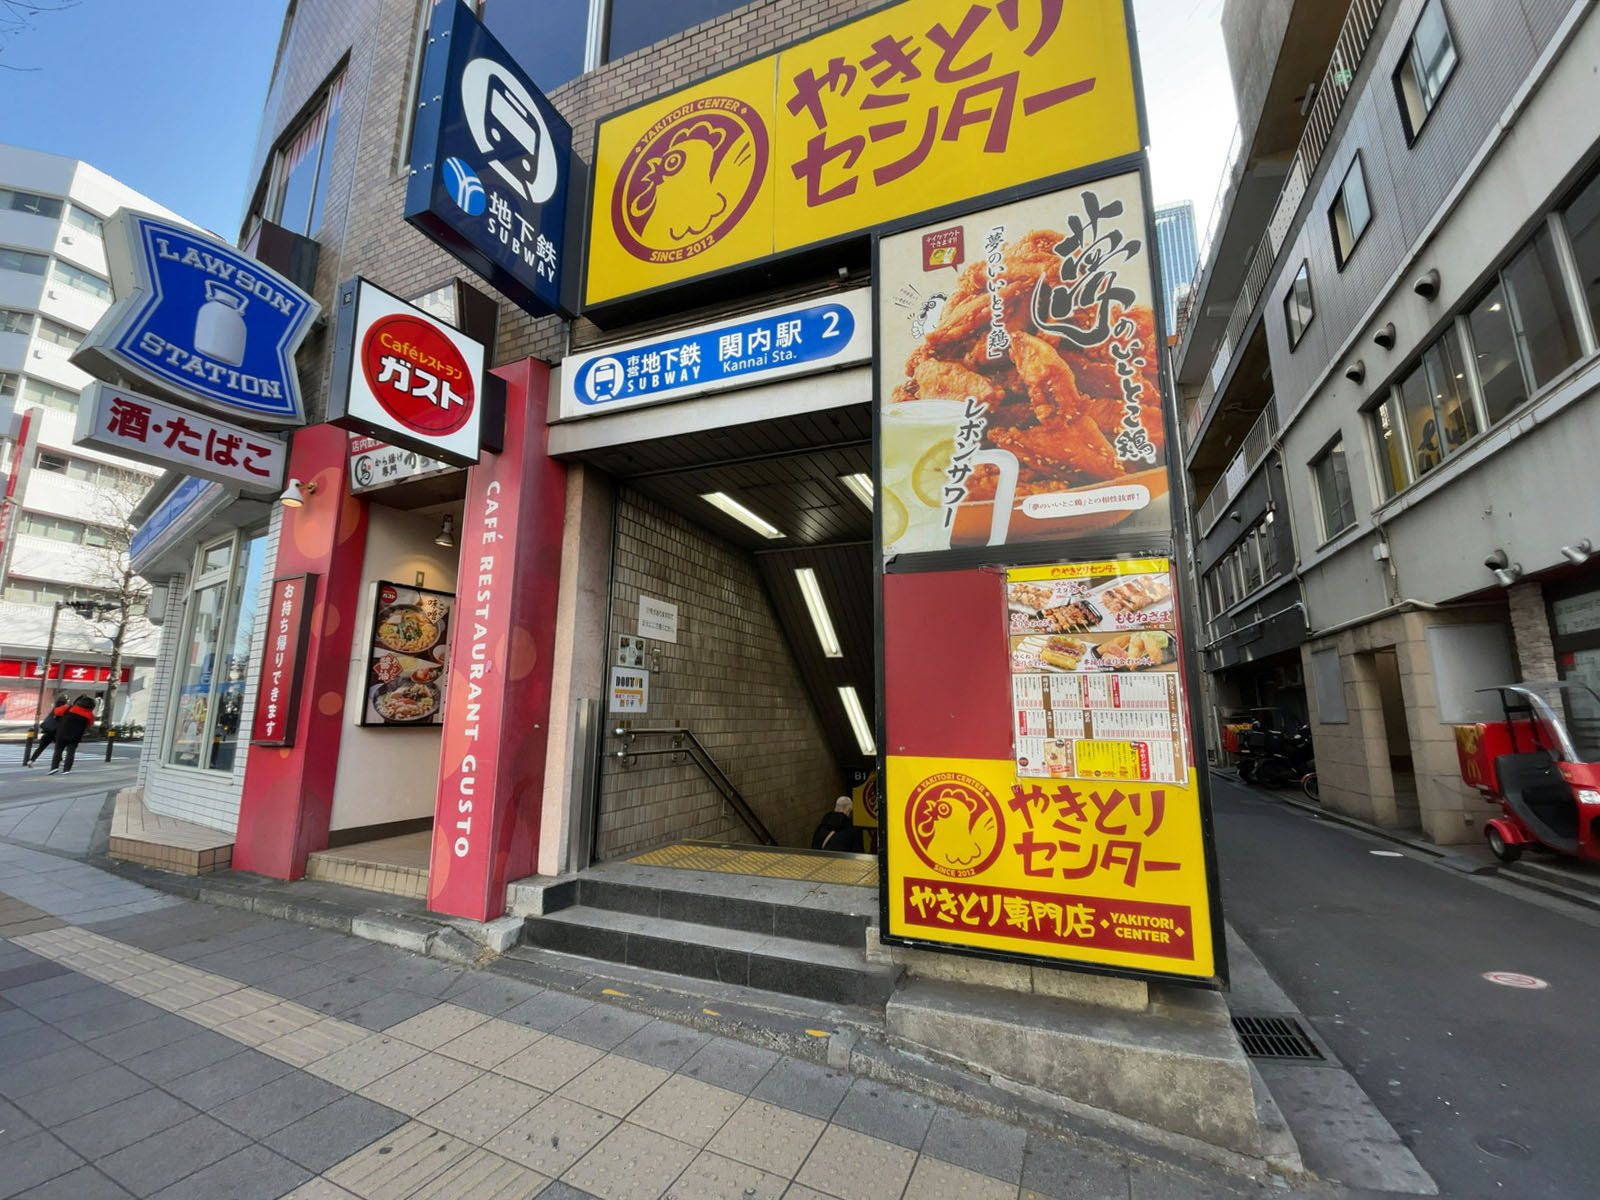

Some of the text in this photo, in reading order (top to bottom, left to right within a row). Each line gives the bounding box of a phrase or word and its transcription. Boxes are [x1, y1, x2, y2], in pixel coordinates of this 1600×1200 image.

[786, 0, 1064, 130] やきとり
[641, 98, 740, 145] YAKITORI CENTER
[791, 71, 1097, 208] センター
[488, 218, 555, 284] SUBWAY
[489, 191, 557, 270] 地下鉄
[649, 235, 715, 262] SINCE 2012
[155, 237, 295, 317] LAWSON
[718, 319, 802, 362] 関内駅
[821, 311, 840, 339] 2
[139, 331, 283, 400] STATION
[377, 354, 465, 411] ガスト
[627, 350, 798, 393] SUBWAY Kannai Sta.
[106, 397, 272, 477] 酒・たばこ
[943, 398, 986, 528] レボンサワー
[265, 583, 295, 737] お持ち帰りできます
[453, 480, 504, 858] CAFÉ RESTAURANT GUSTO
[920, 773, 985, 792] YAKITORI CENTER
[1008, 784, 1165, 837] やきとり
[933, 864, 976, 877] SINCE 2012
[1013, 831, 1182, 888] センター
[909, 885, 1096, 938] やきとり専門店
[1109, 912, 1174, 930] YAKITORI
[1114, 927, 1170, 944] CENTER
